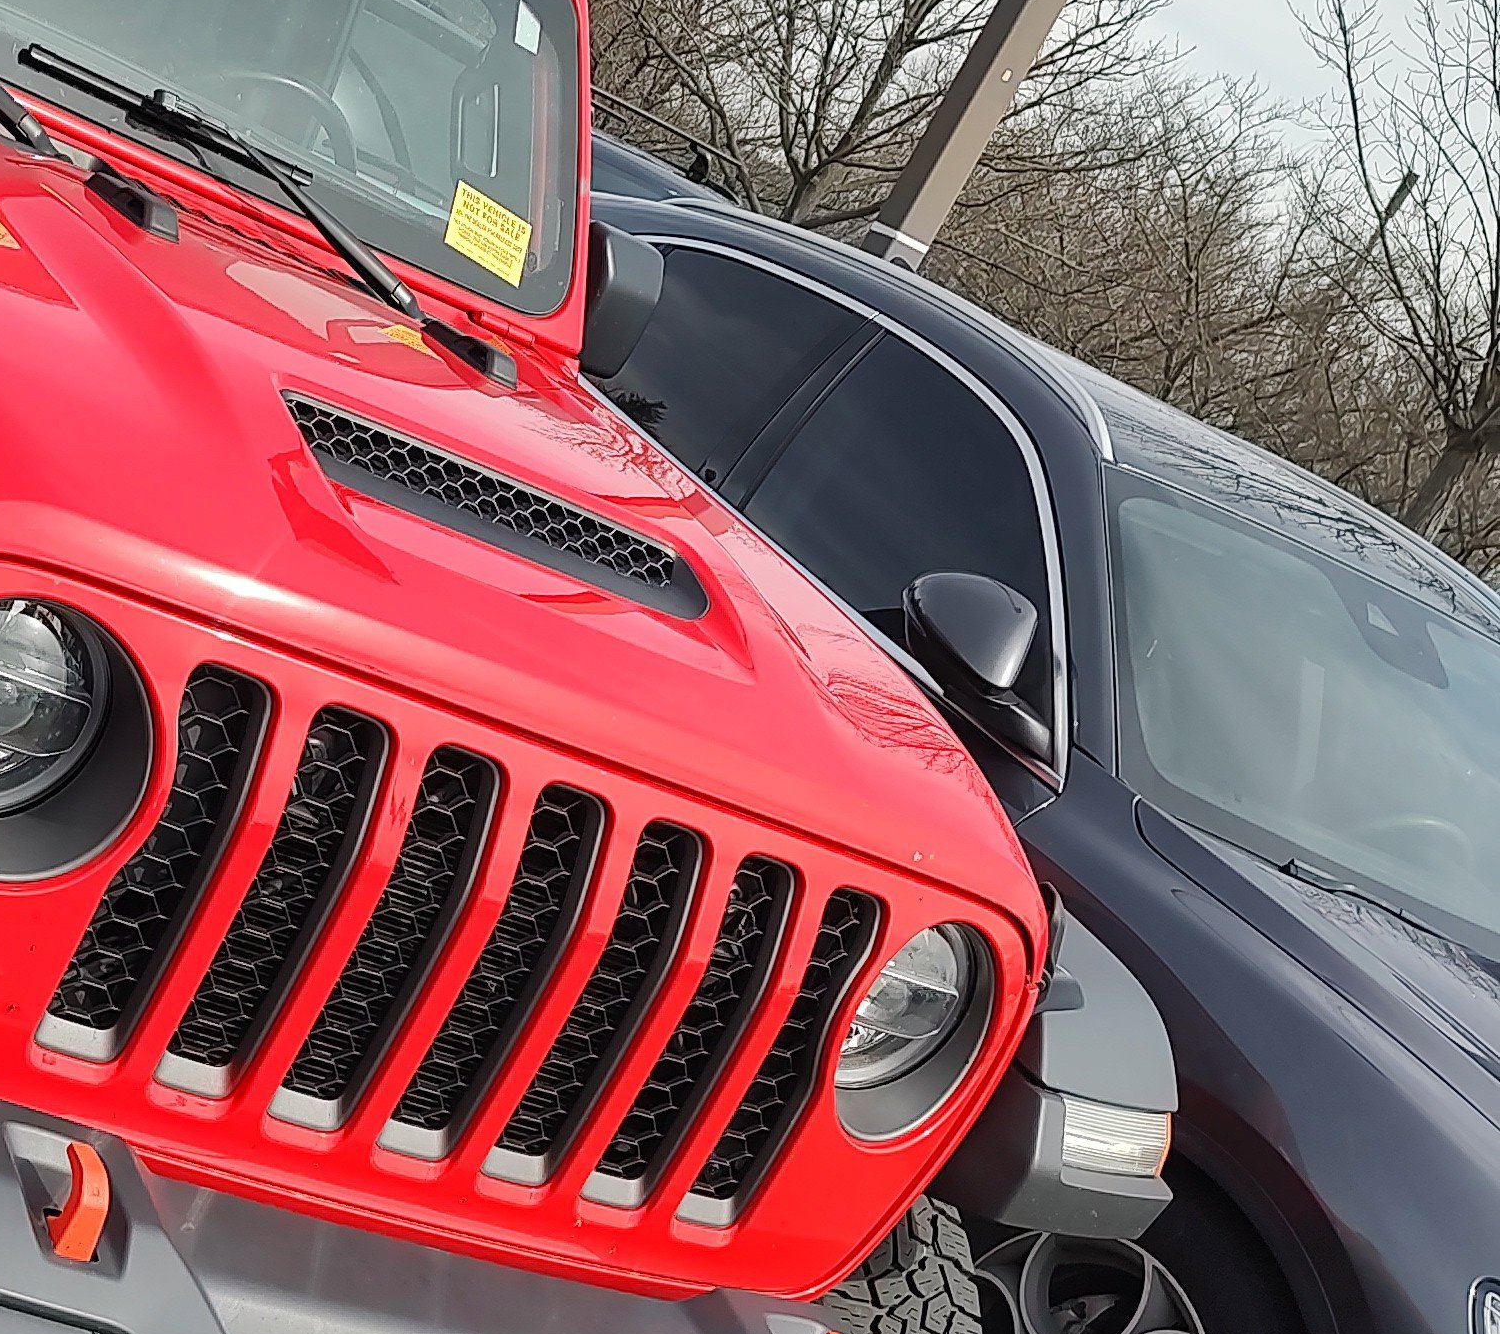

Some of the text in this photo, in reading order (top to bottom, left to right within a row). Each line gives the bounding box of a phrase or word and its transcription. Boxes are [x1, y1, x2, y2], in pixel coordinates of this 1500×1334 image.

[462, 188, 526, 235] THIS VEHICLE IS
[463, 200, 521, 242] NOT FOR SALE
